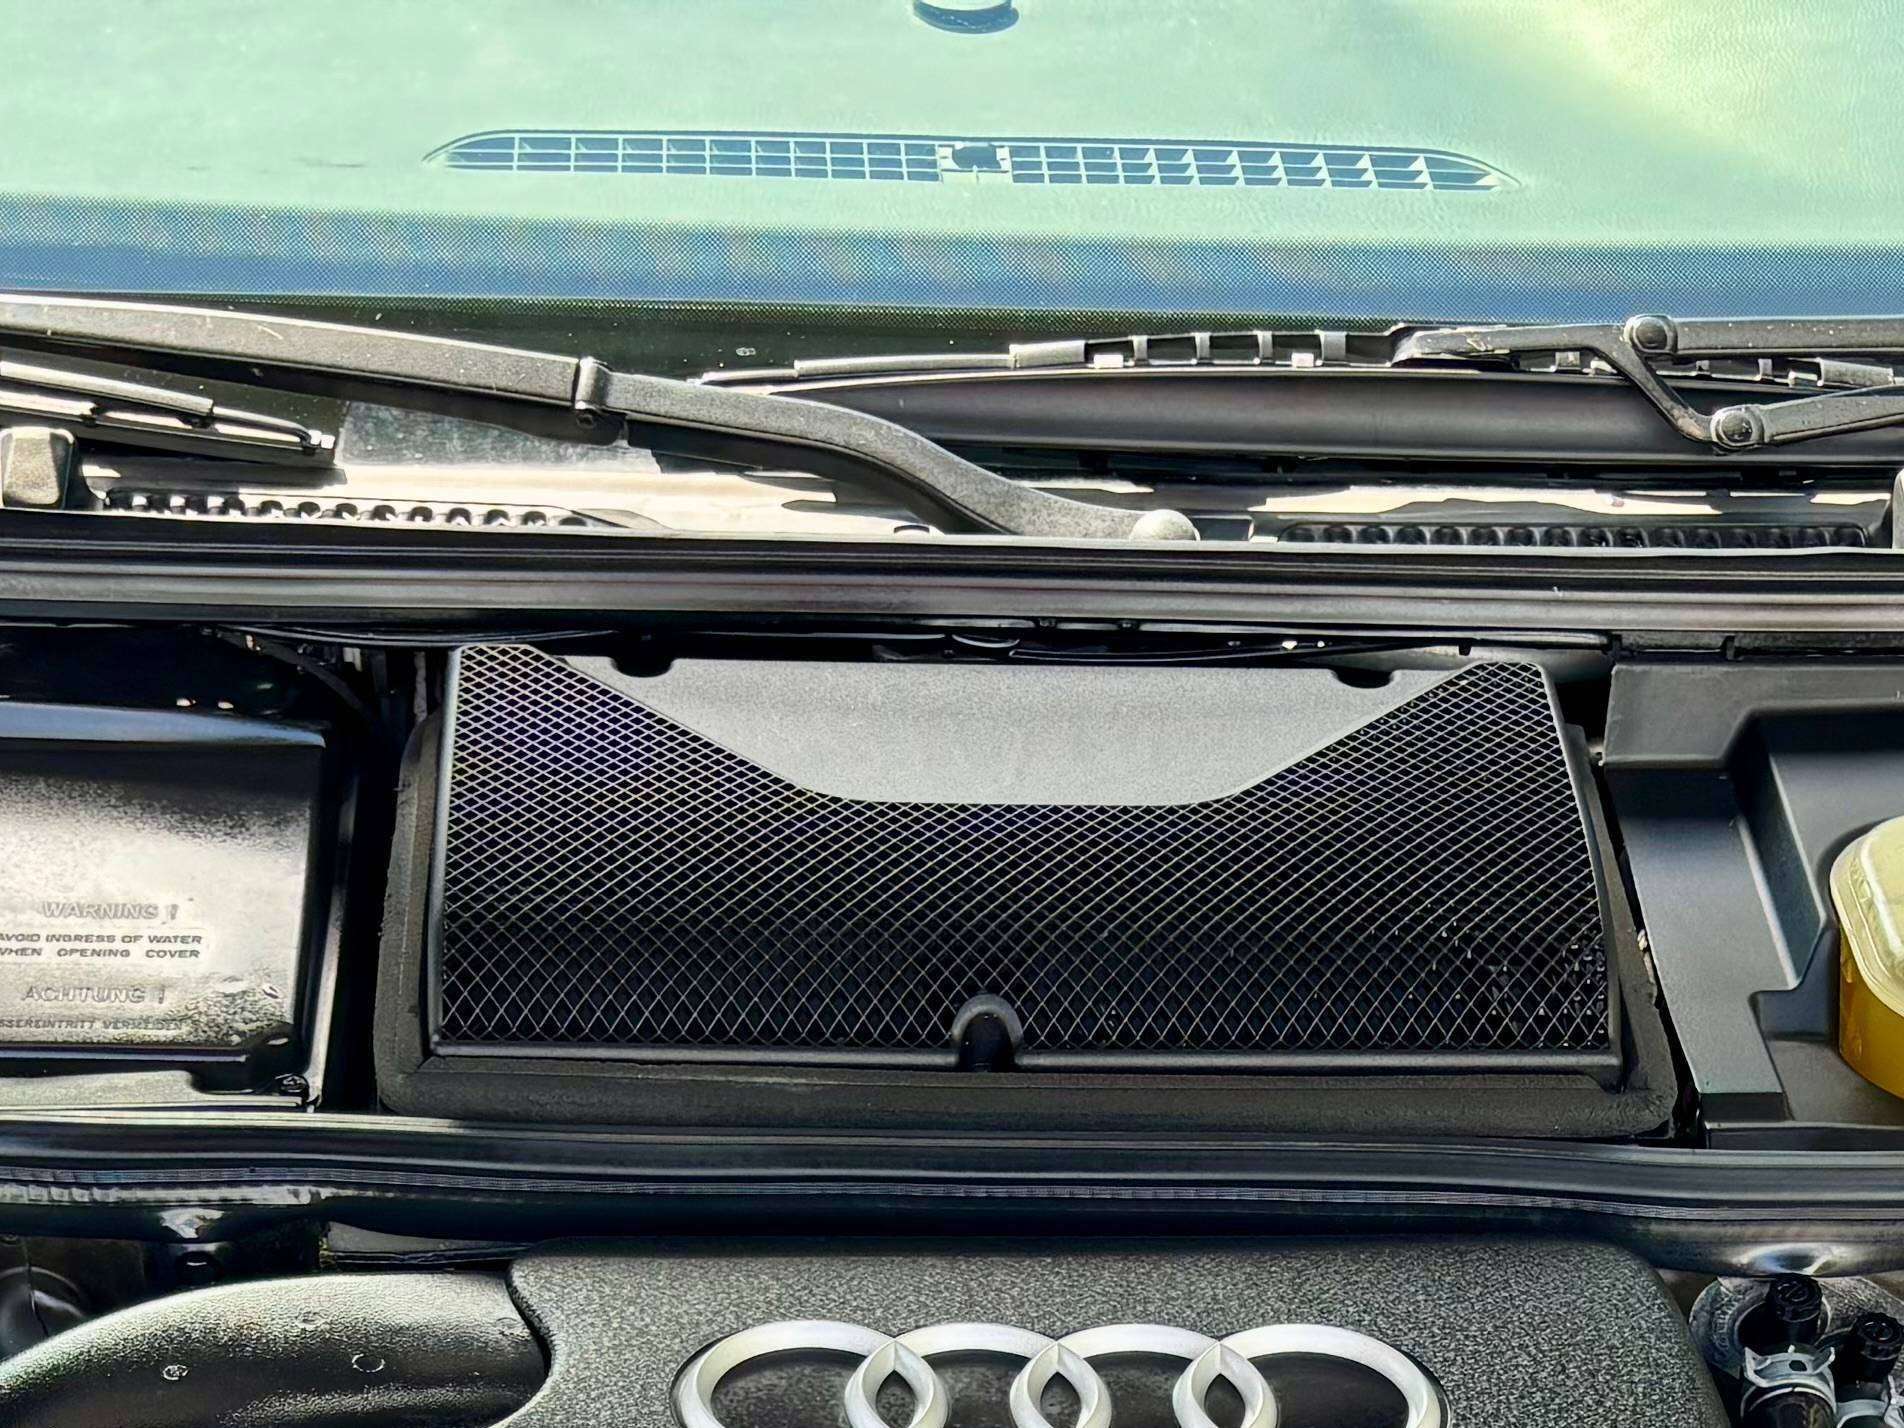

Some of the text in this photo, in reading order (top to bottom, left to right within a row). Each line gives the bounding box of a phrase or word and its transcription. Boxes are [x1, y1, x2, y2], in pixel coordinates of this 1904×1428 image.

[40, 902, 161, 921] WARNING
[45, 933, 116, 944] INGRESS
[120, 934, 143, 945] OF
[147, 934, 203, 946] WATER
[56, 947, 131, 959] OPENING
[145, 948, 201, 959] COVER
[21, 985, 146, 1004] ACHTUNG
